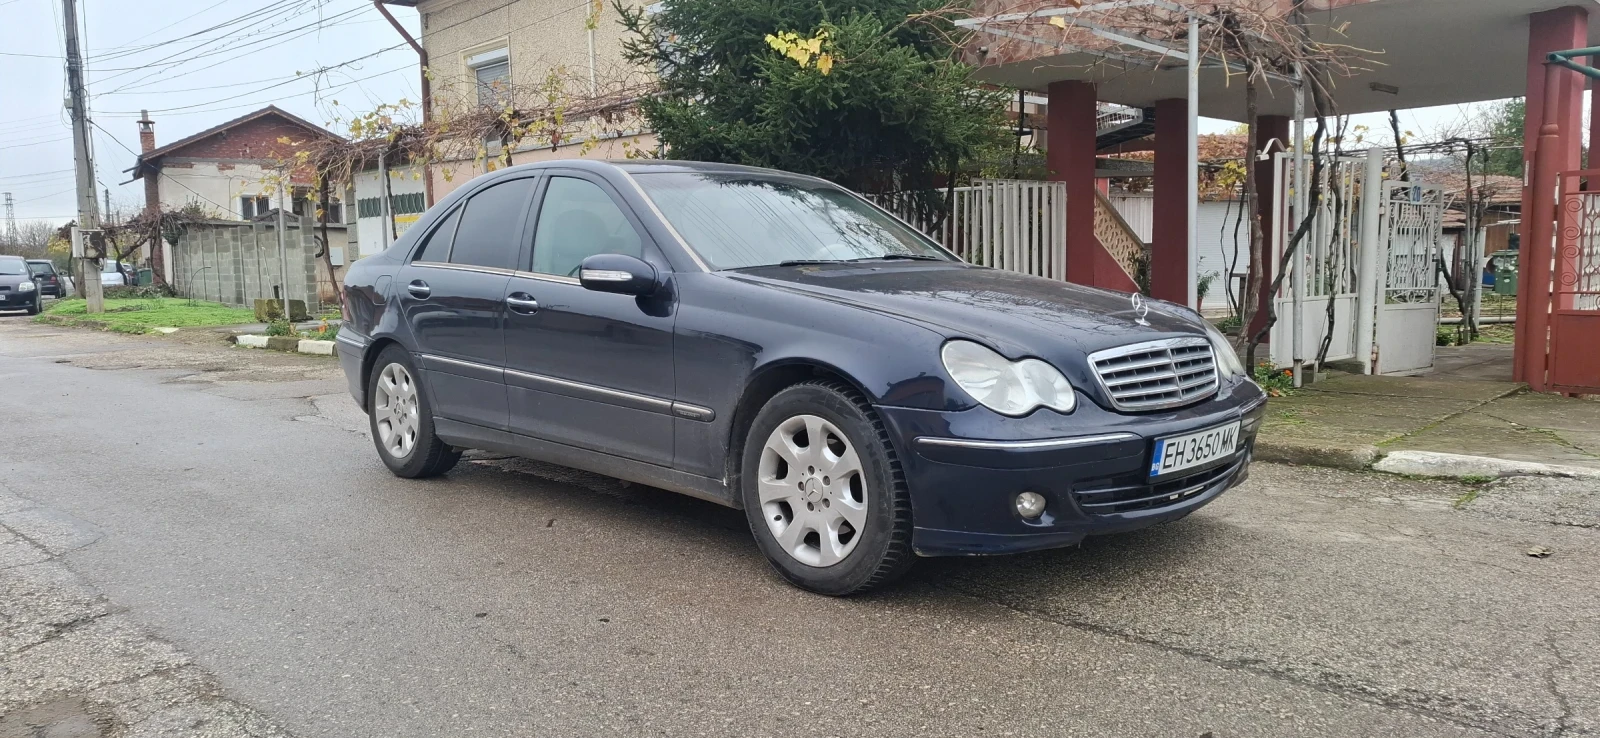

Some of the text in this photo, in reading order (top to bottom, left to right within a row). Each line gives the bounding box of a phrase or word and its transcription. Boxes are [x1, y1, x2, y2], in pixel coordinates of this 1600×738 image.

[1412, 185, 1421, 202] 20
[1162, 425, 1237, 469] EH 3650 MK
